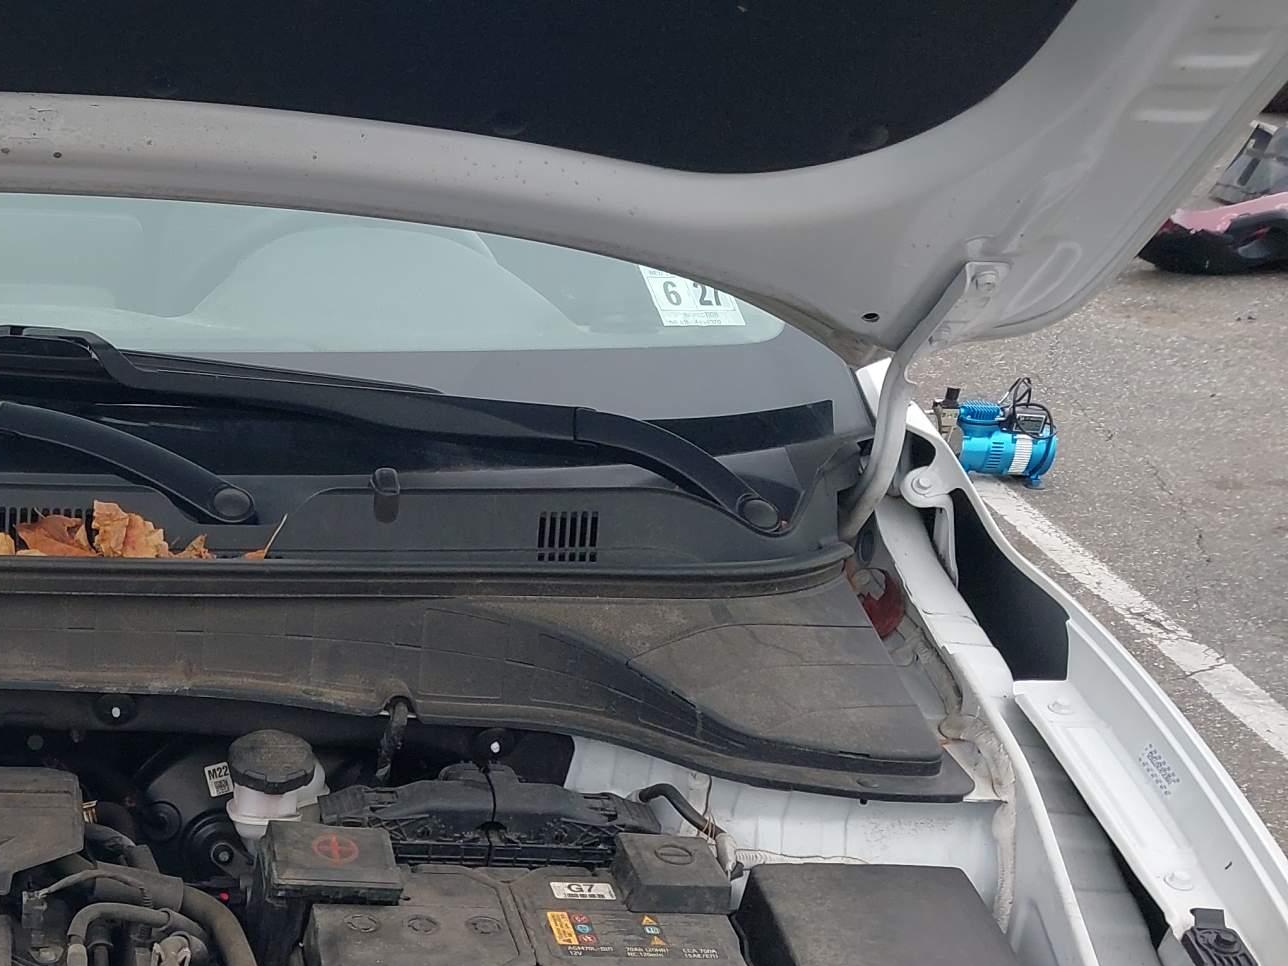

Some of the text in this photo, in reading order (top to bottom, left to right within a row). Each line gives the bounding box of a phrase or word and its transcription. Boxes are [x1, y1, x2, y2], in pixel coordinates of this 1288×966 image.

[662, 281, 682, 306] 6
[208, 765, 229, 780] M22
[567, 883, 595, 894] G7
